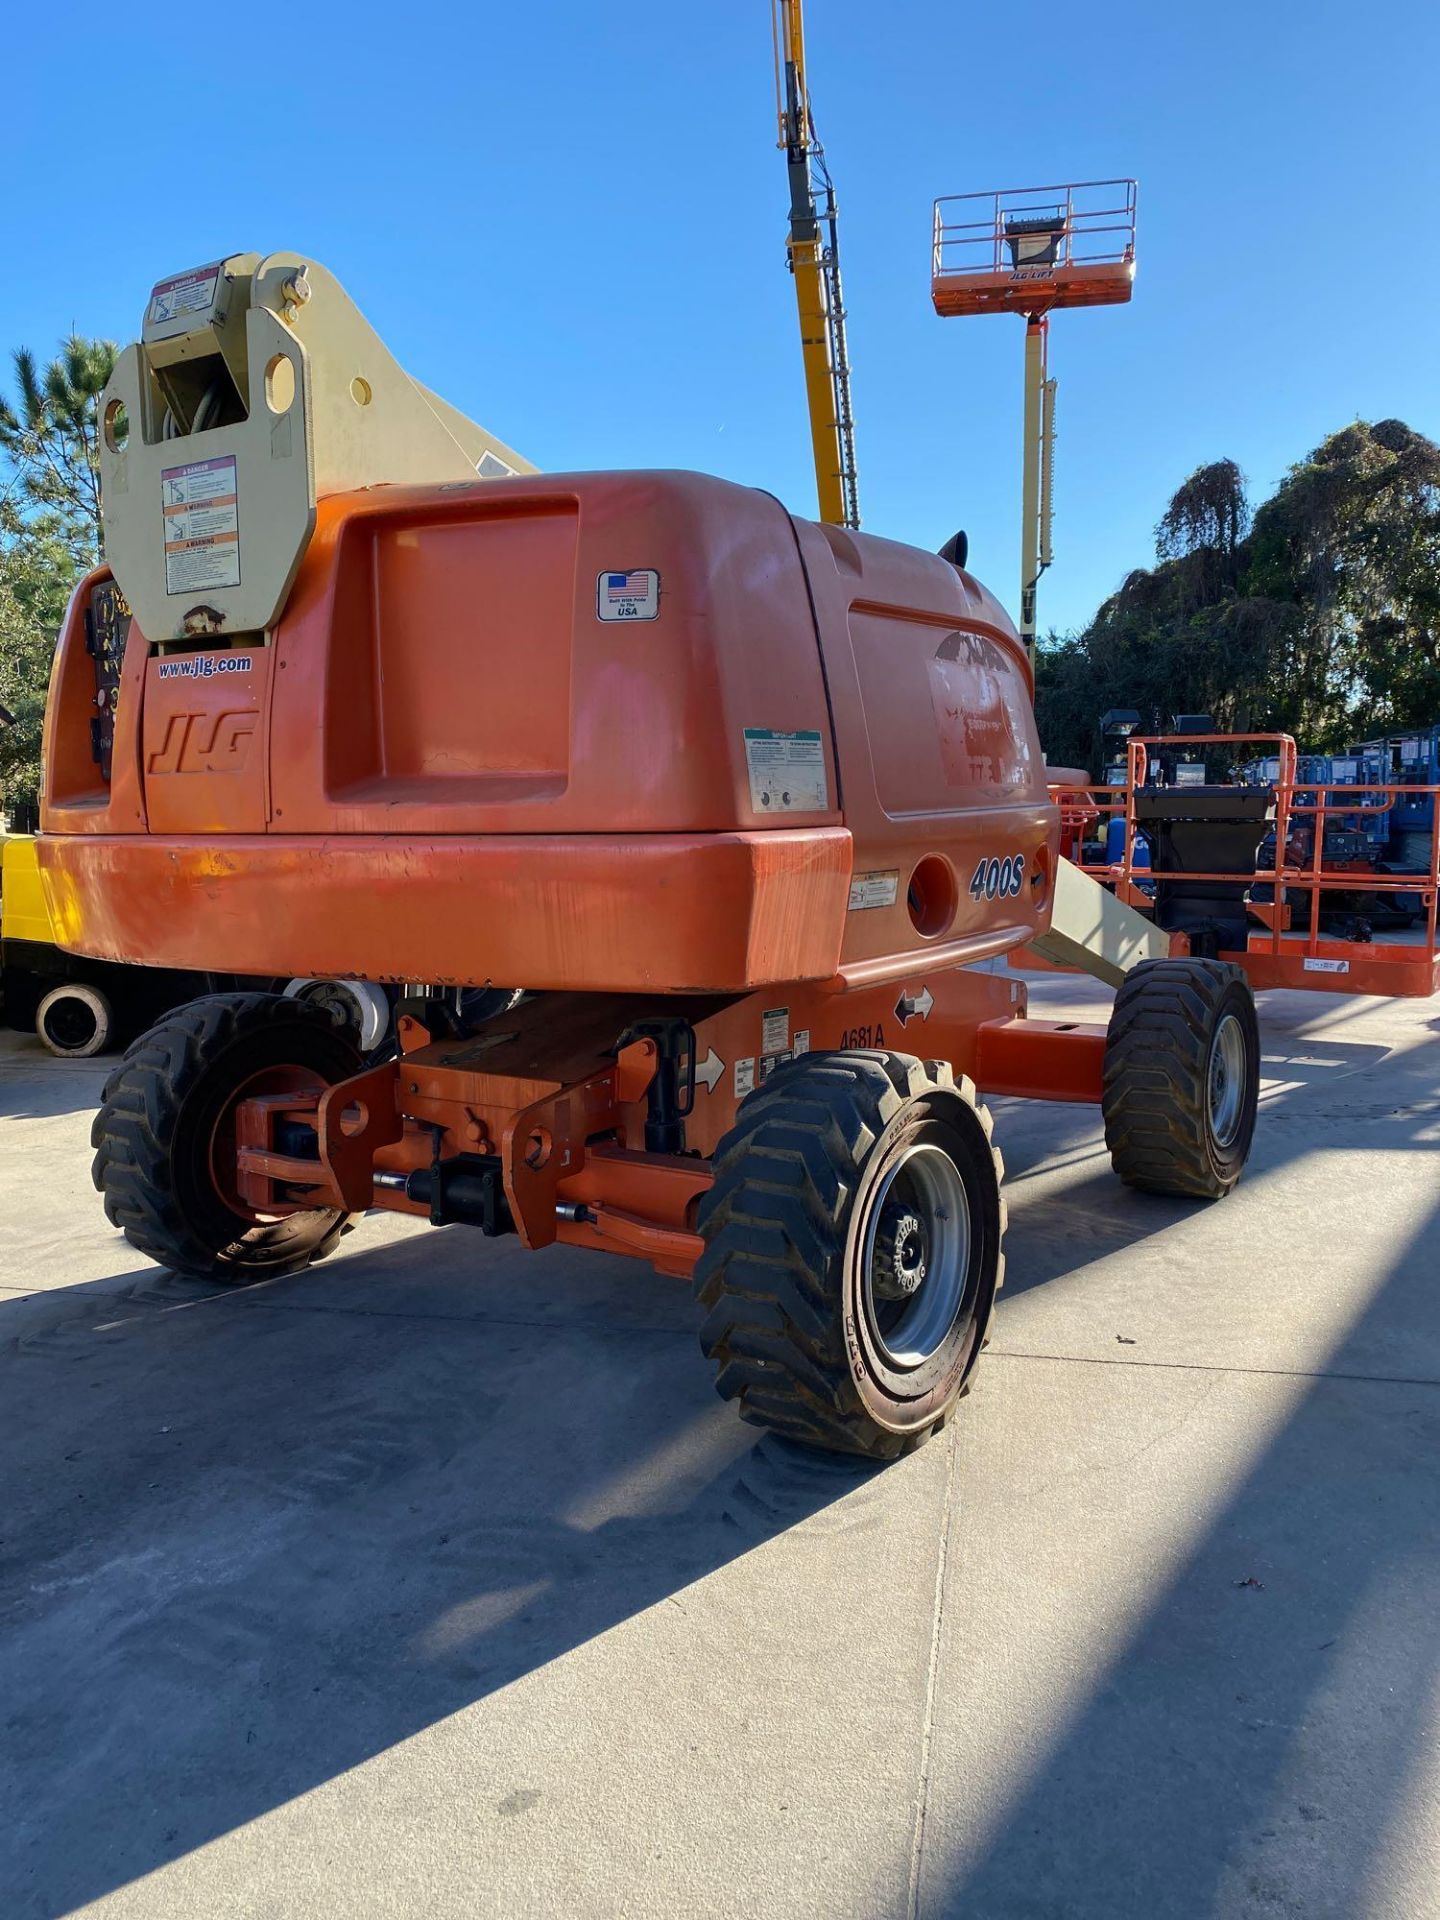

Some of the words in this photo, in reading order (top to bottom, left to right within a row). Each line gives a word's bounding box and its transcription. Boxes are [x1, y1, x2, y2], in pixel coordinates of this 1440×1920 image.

[1010, 272, 1028, 280] JLG
[1031, 271, 1053, 279] LIFT
[618, 608, 637, 616] USA
[159, 657, 252, 678] www.jlg.com
[148, 710, 260, 774] JLG
[968, 853, 1026, 902] 400S
[840, 1023, 885, 1050] 4681A
